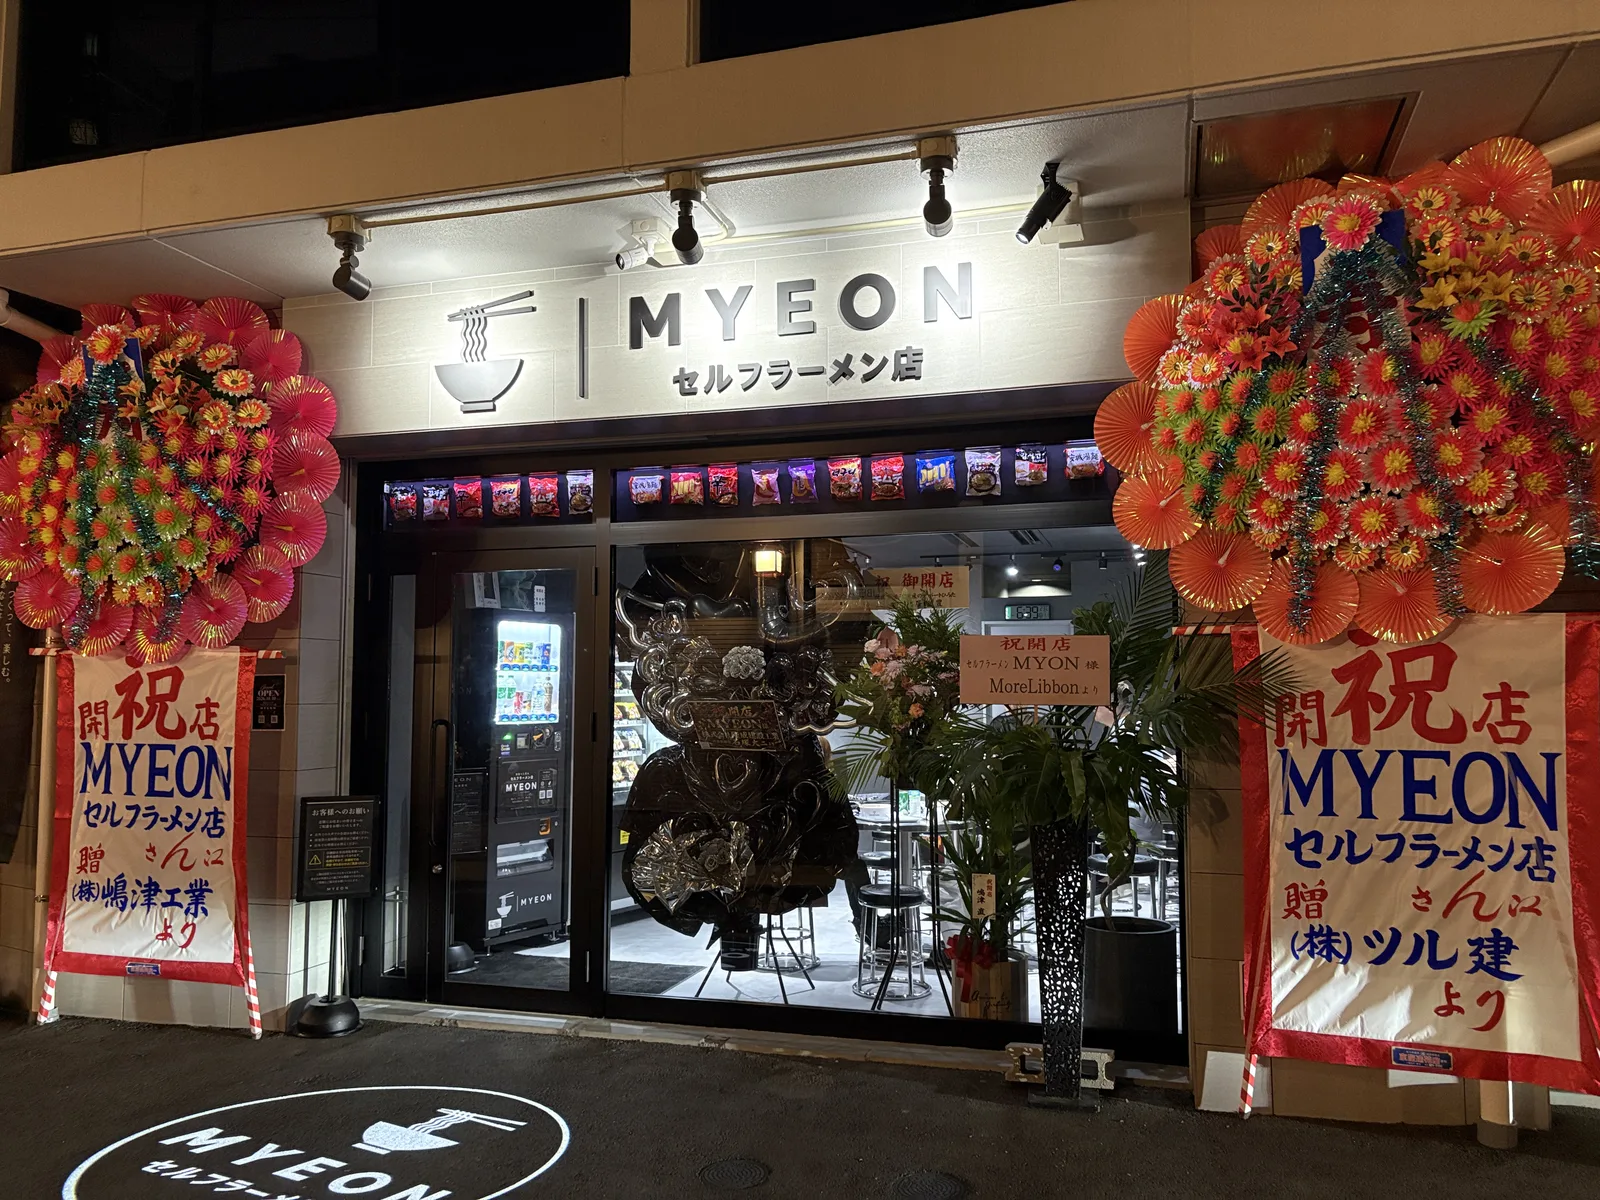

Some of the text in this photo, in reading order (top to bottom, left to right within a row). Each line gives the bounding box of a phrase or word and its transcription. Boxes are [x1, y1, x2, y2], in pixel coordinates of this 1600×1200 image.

[628, 262, 975, 350] MYEON
[672, 345, 926, 396] セルフラーメン店
[902, 571, 954, 589] 御開店
[966, 656, 1100, 670] セルフラーメン MYON 様
[1000, 637, 1071, 651] 祝開店
[113, 657, 186, 742] 祝
[990, 679, 1079, 696] MoreLibbon
[1331, 628, 1467, 745] 祝
[79, 698, 220, 741] 開 店
[1473, 682, 1531, 745] 店
[80, 742, 233, 801] MYEON
[505, 782, 537, 792] MYEON
[1277, 748, 1562, 831] MYEON
[84, 801, 226, 839] セルフラーメン店
[312, 807, 370, 816] お客様へのお願い
[76, 832, 223, 875] 贈 さん江
[1284, 827, 1557, 882] セルフラーメン店
[520, 893, 552, 906] MYEON
[1283, 870, 1542, 922] 贈 さん江
[155, 917, 196, 949] より
[1434, 981, 1506, 1032] より
[159, 1127, 452, 1200] MYEON
